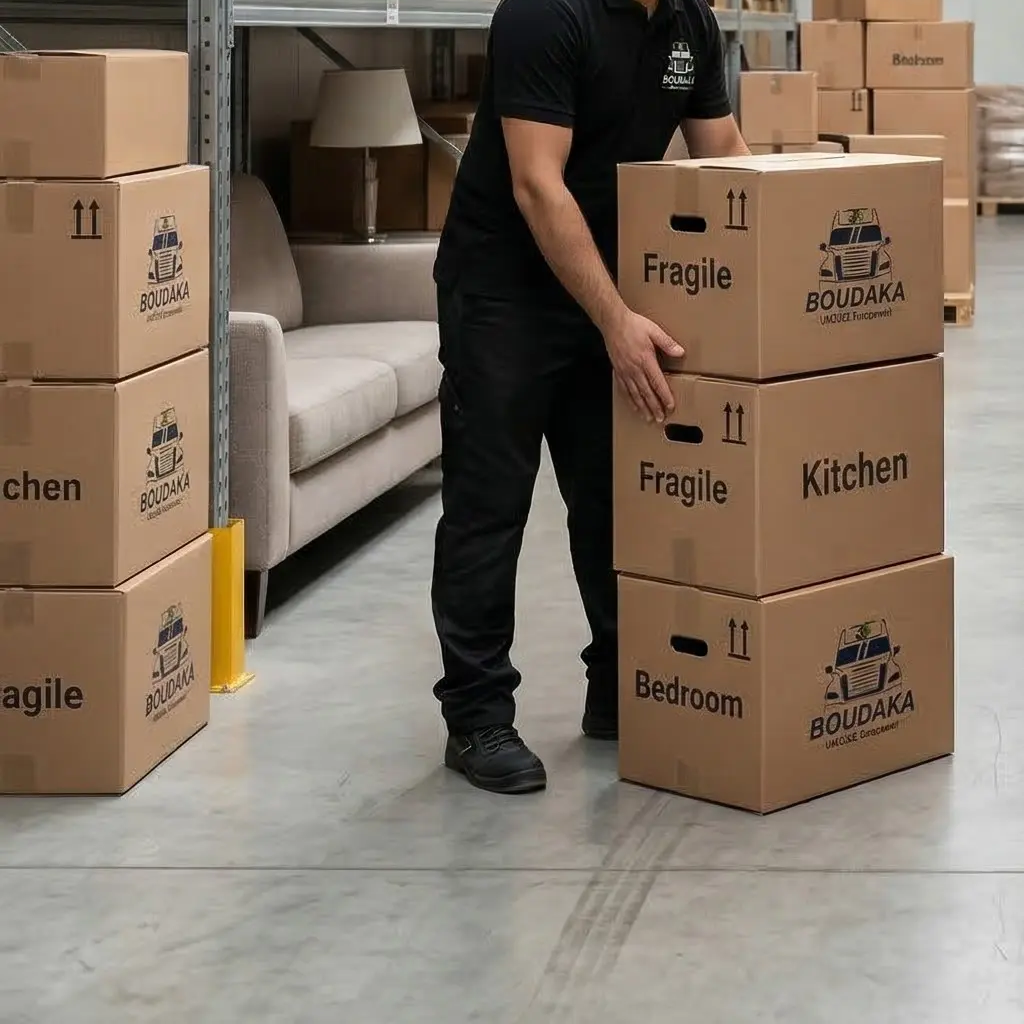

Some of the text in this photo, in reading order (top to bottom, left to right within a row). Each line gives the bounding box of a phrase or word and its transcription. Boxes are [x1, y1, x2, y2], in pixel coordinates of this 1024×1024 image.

[644, 252, 732, 295] Fragile
[140, 280, 190, 313] BOUDAKA
[805, 281, 906, 313] BOUDAKA
[140, 472, 190, 513] BOUDAKA
[640, 460, 728, 507] Fragile
[802, 451, 908, 499] Kitchen
[635, 669, 743, 718] Bedroom
[809, 689, 915, 740] BOUDAKA
